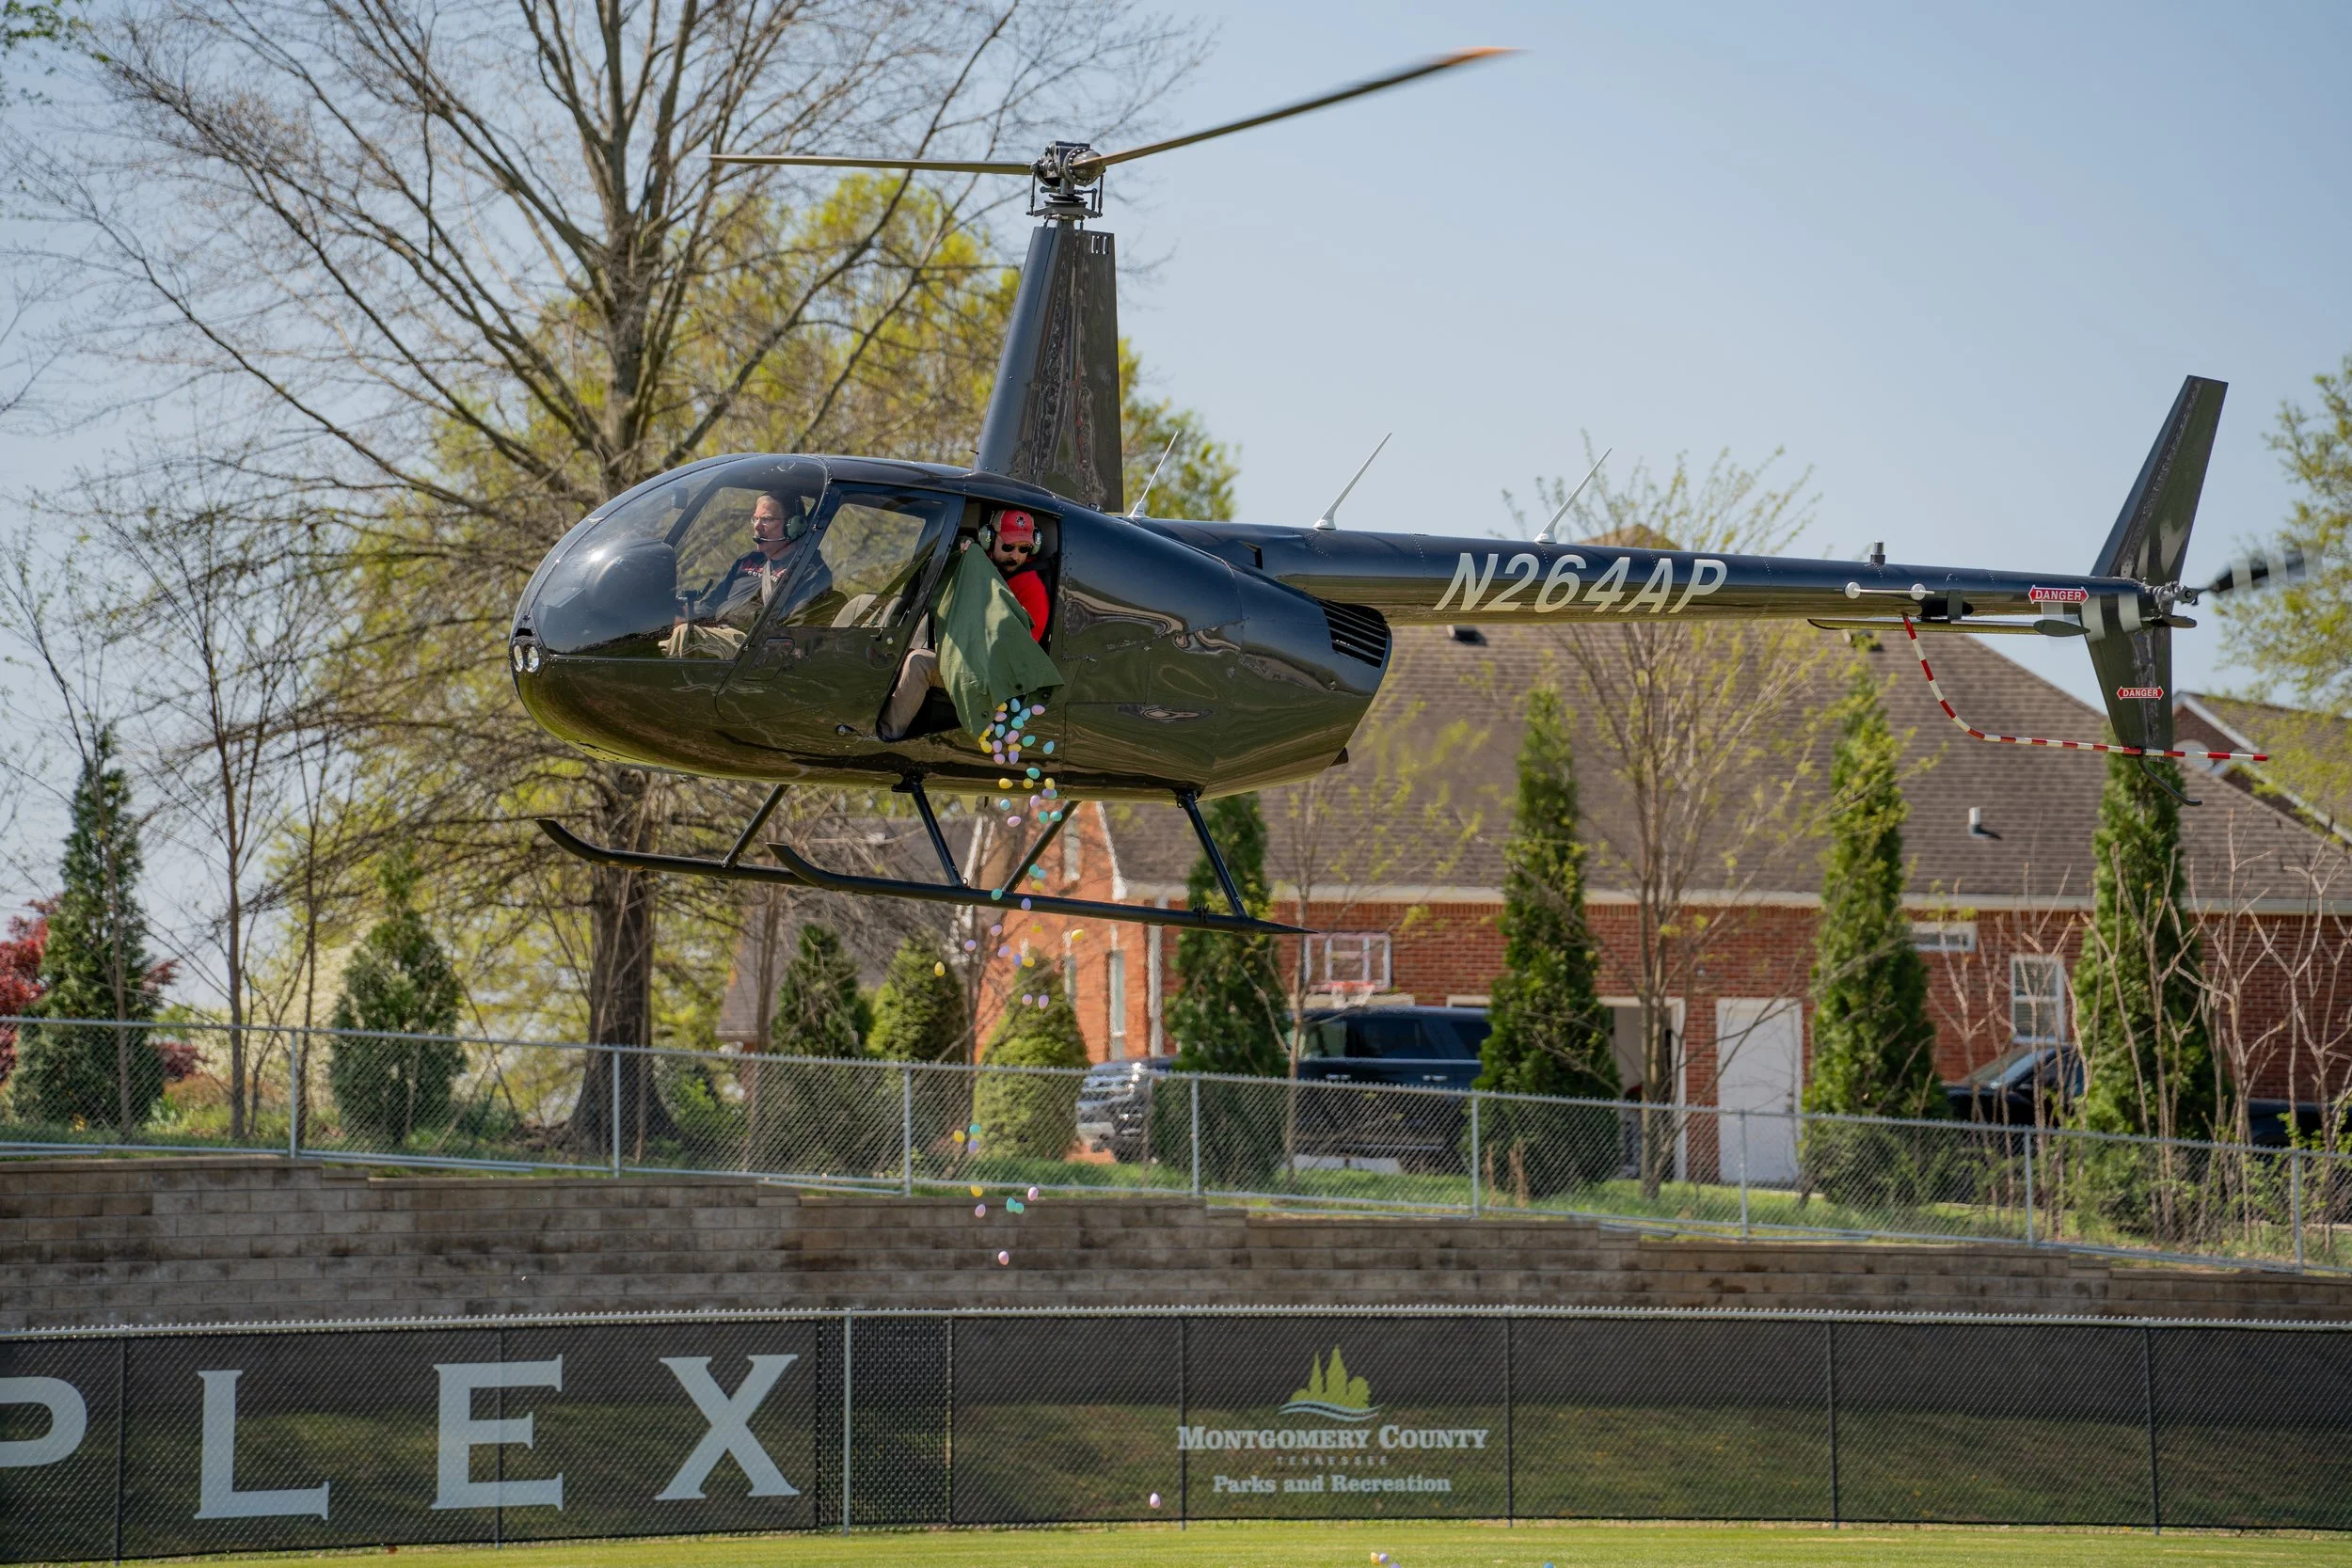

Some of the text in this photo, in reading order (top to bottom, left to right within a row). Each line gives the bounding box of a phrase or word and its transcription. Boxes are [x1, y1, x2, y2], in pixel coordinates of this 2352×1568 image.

[1433, 552, 1727, 613] N264AP
[2035, 590, 2082, 601] DANGER
[2122, 689, 2158, 697] DANGER
[1177, 1424, 1489, 1449] MONTGOMERY COUNTY
[1277, 1455, 1388, 1465] TENNESSEE
[1213, 1473, 1452, 1494] Parks and Recreation
